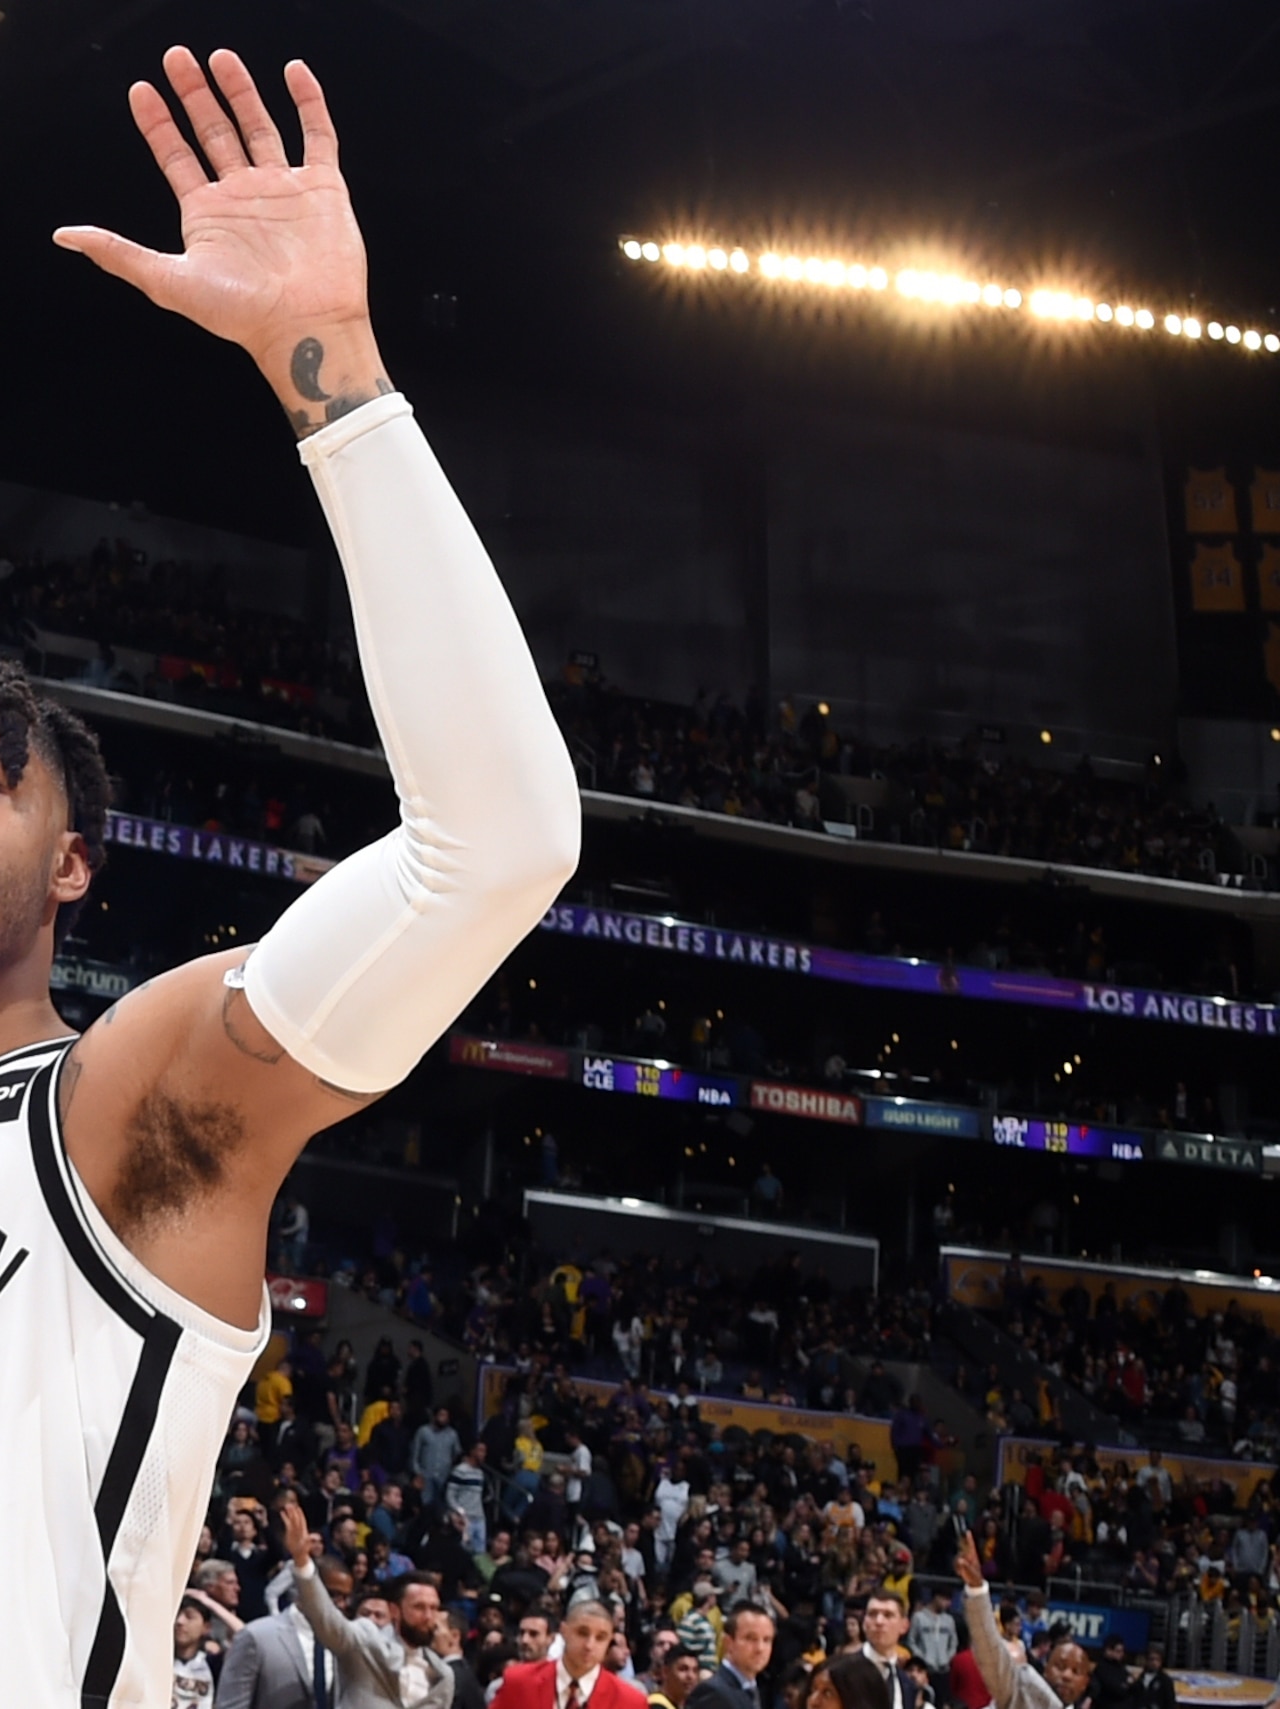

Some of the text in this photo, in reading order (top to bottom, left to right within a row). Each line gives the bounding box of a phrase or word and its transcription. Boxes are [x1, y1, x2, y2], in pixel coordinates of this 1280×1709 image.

[192, 834, 297, 878] LAKERS
[583, 913, 707, 955] ANGELES
[715, 934, 813, 973] LAKERS
[1082, 985, 1134, 1016] LOS
[1143, 995, 1257, 1033] ANGELES
[583, 1056, 614, 1075] LAC
[583, 1072, 615, 1092] CLE
[698, 1087, 732, 1106] NBA
[754, 1084, 860, 1122] TOSHIBA
[1111, 1142, 1144, 1161] NBA
[1184, 1139, 1255, 1168] DELTA
